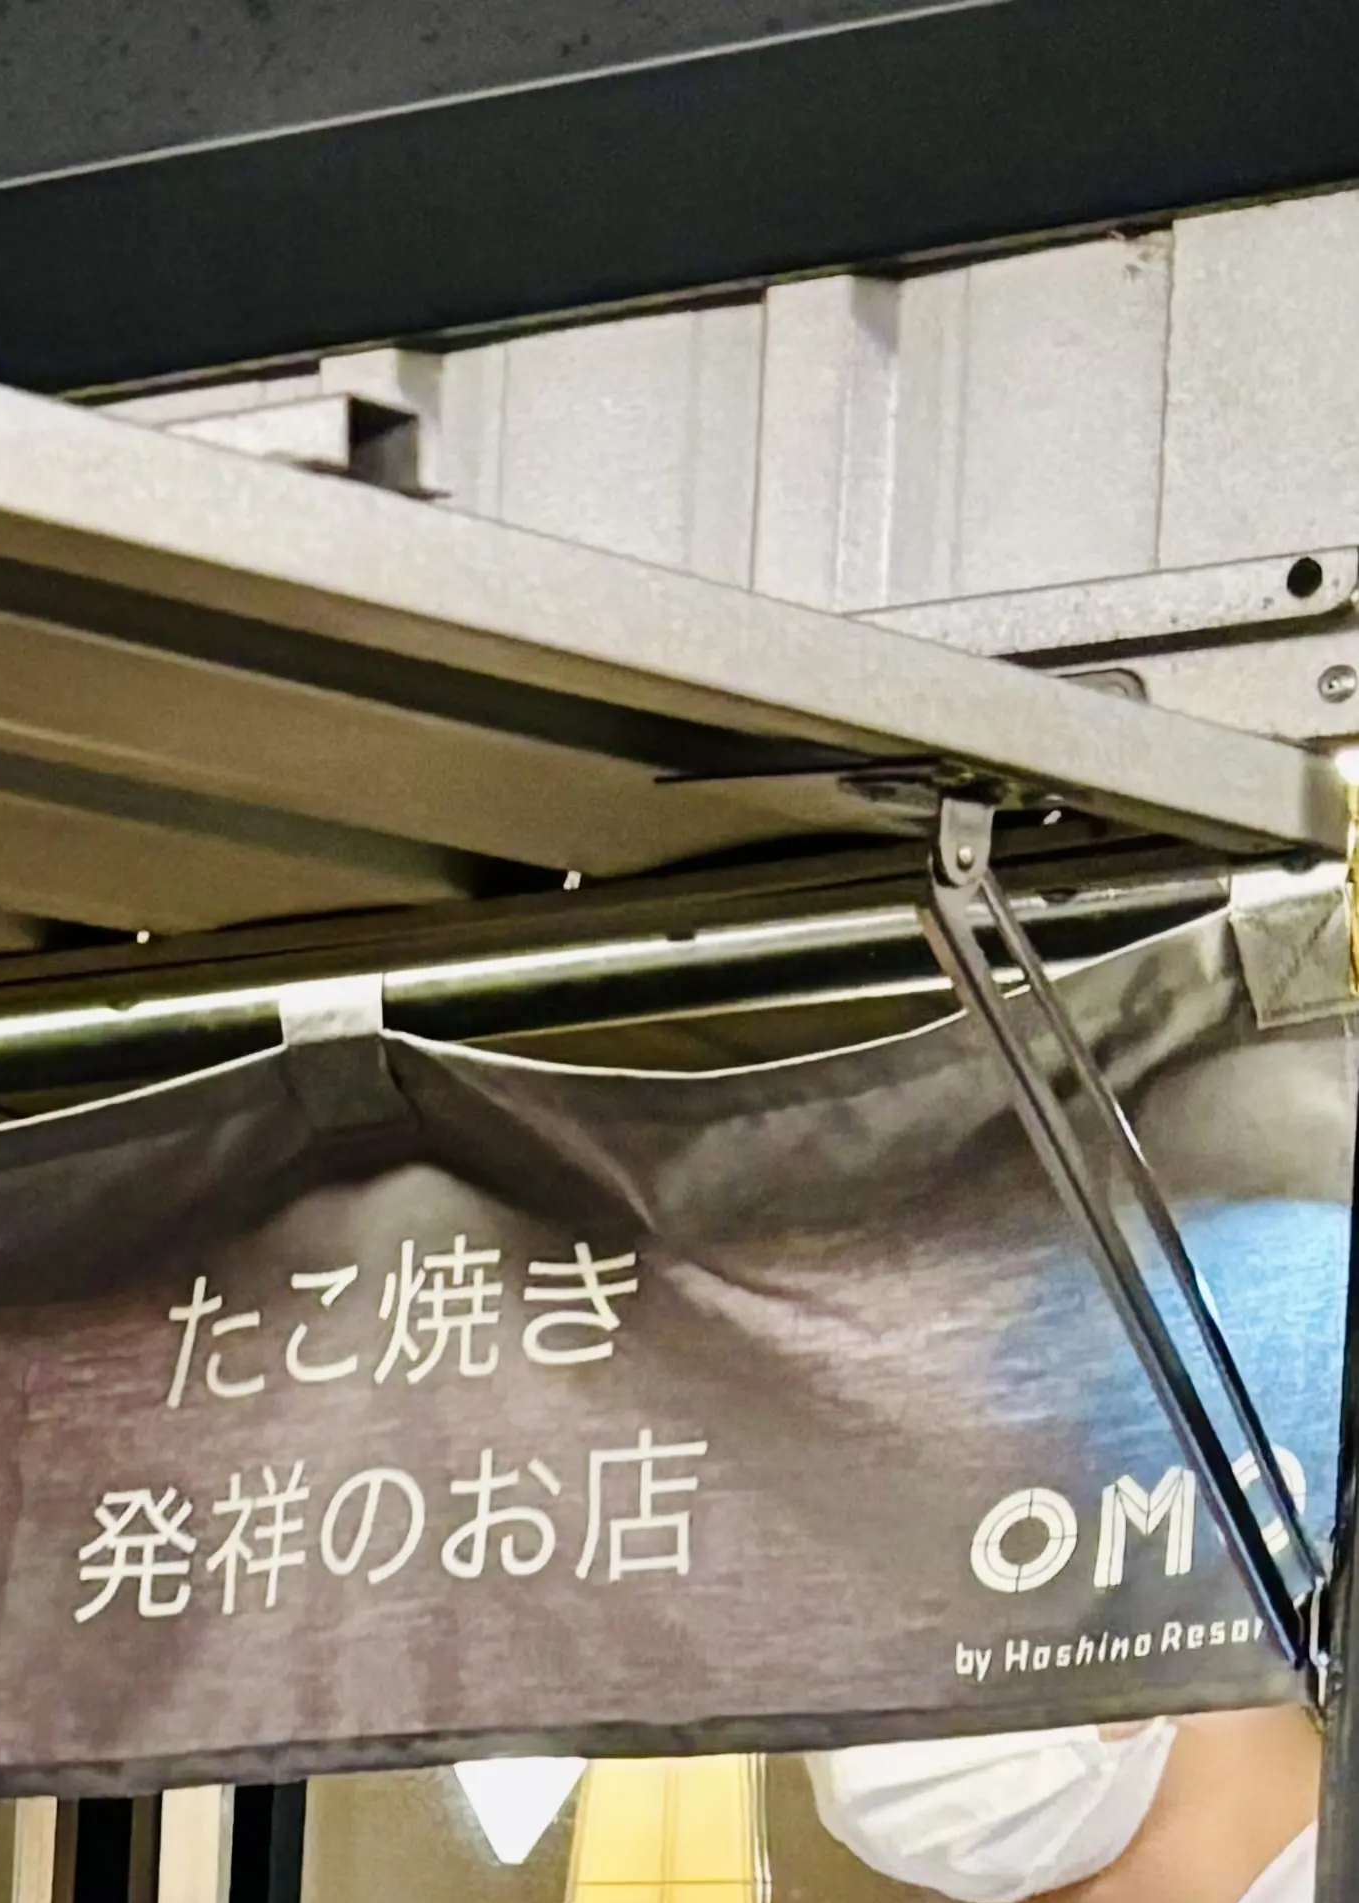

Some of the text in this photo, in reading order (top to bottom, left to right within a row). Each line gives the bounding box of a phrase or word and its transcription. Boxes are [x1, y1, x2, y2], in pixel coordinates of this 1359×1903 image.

[167, 1234, 639, 1408] たこ焼き
[74, 1428, 708, 1623] 発祥のお店
[955, 1642, 993, 1681] by
[1004, 1631, 1152, 1674] Hoshino
